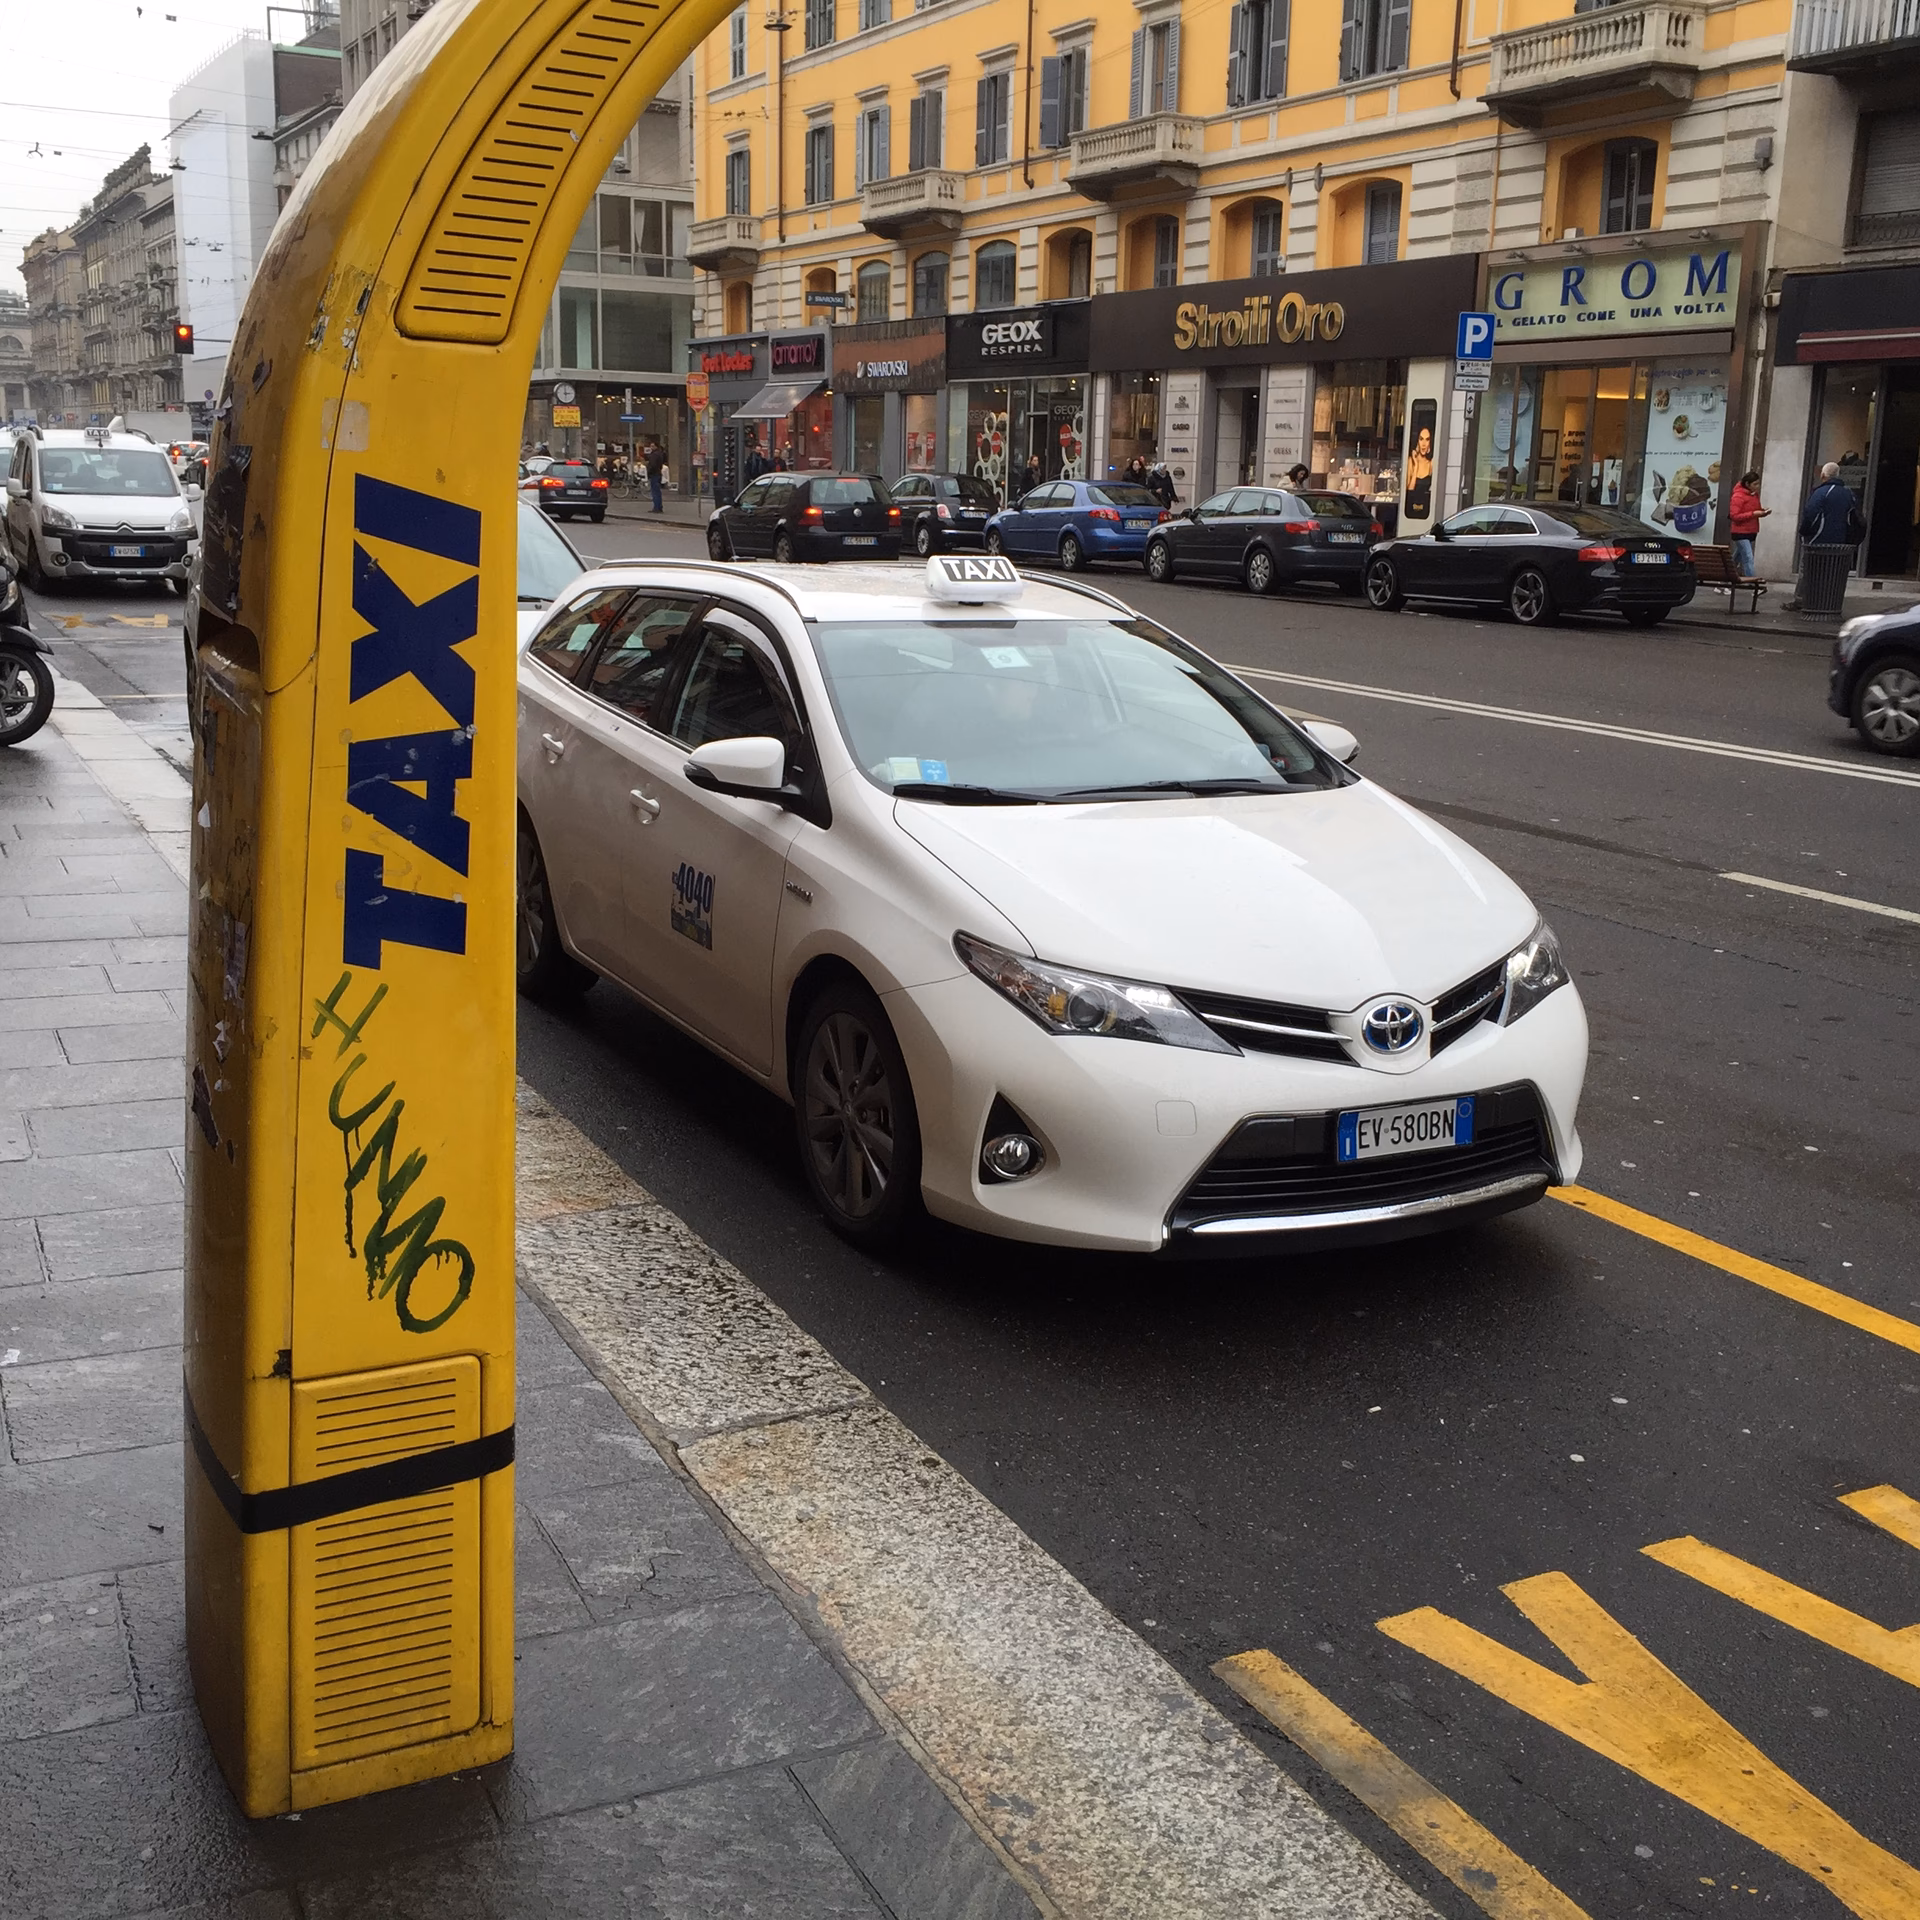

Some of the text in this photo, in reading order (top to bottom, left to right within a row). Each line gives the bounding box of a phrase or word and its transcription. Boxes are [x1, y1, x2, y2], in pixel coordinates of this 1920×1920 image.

[1494, 250, 1731, 311] GROM
[1174, 292, 1345, 350] Stroili Oro
[1511, 314, 1567, 327] GELATO
[1576, 310, 1616, 322] COME
[1630, 306, 1663, 318] UNA
[1674, 302, 1726, 315] VOLTA
[981, 319, 1043, 345] GEOX
[1464, 317, 1489, 355] P
[981, 343, 1043, 356] RESPIRA
[867, 360, 909, 378] SWAROVSKI
[1054, 405, 1082, 415] GEOX
[87, 429, 109, 437] TAXI
[1172, 423, 1191, 431] CASIO
[1273, 447, 1292, 455] GUESS
[942, 559, 1013, 580] TAXI
[342, 472, 483, 971] TAXI
[677, 862, 713, 919] 4040
[1390, 1108, 1454, 1145] 580BN
